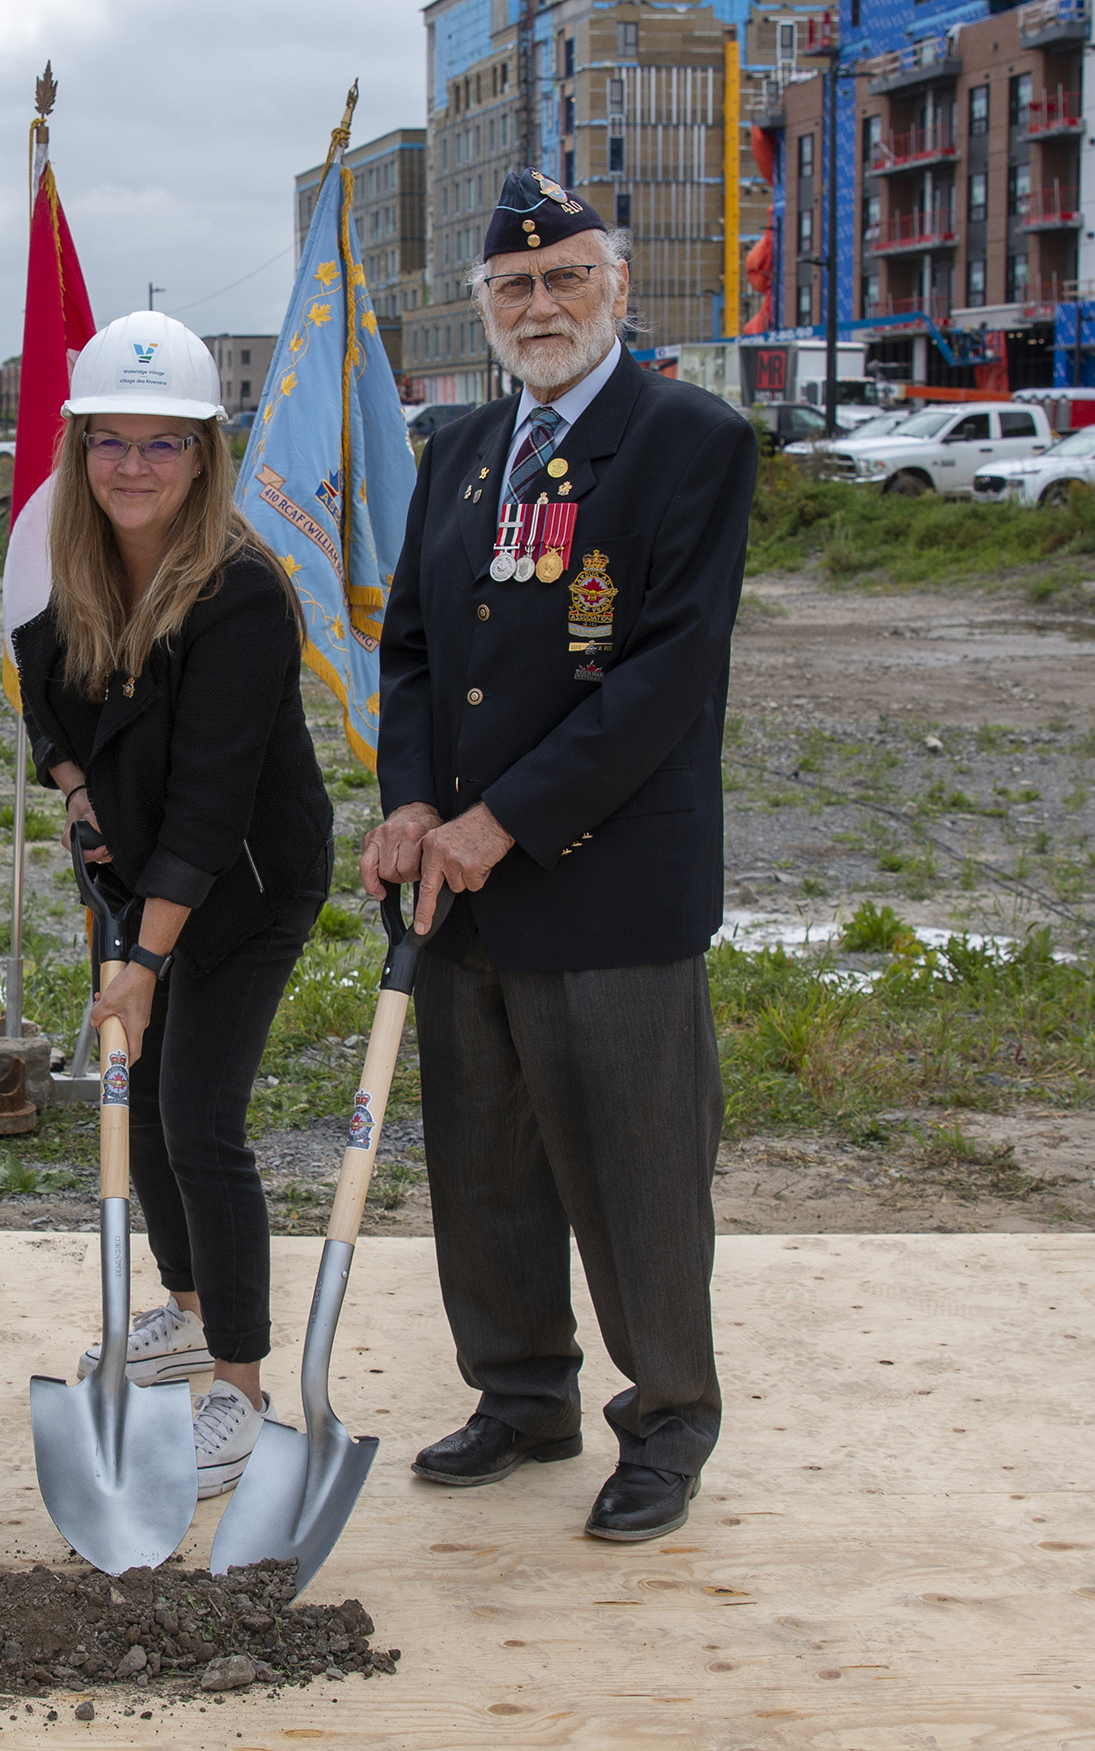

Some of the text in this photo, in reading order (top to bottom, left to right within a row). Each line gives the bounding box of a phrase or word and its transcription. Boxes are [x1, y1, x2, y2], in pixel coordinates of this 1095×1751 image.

[561, 200, 584, 214] 410
[759, 355, 783, 385] MR
[264, 488, 338, 564] 410 RCAF (WILLIAM
